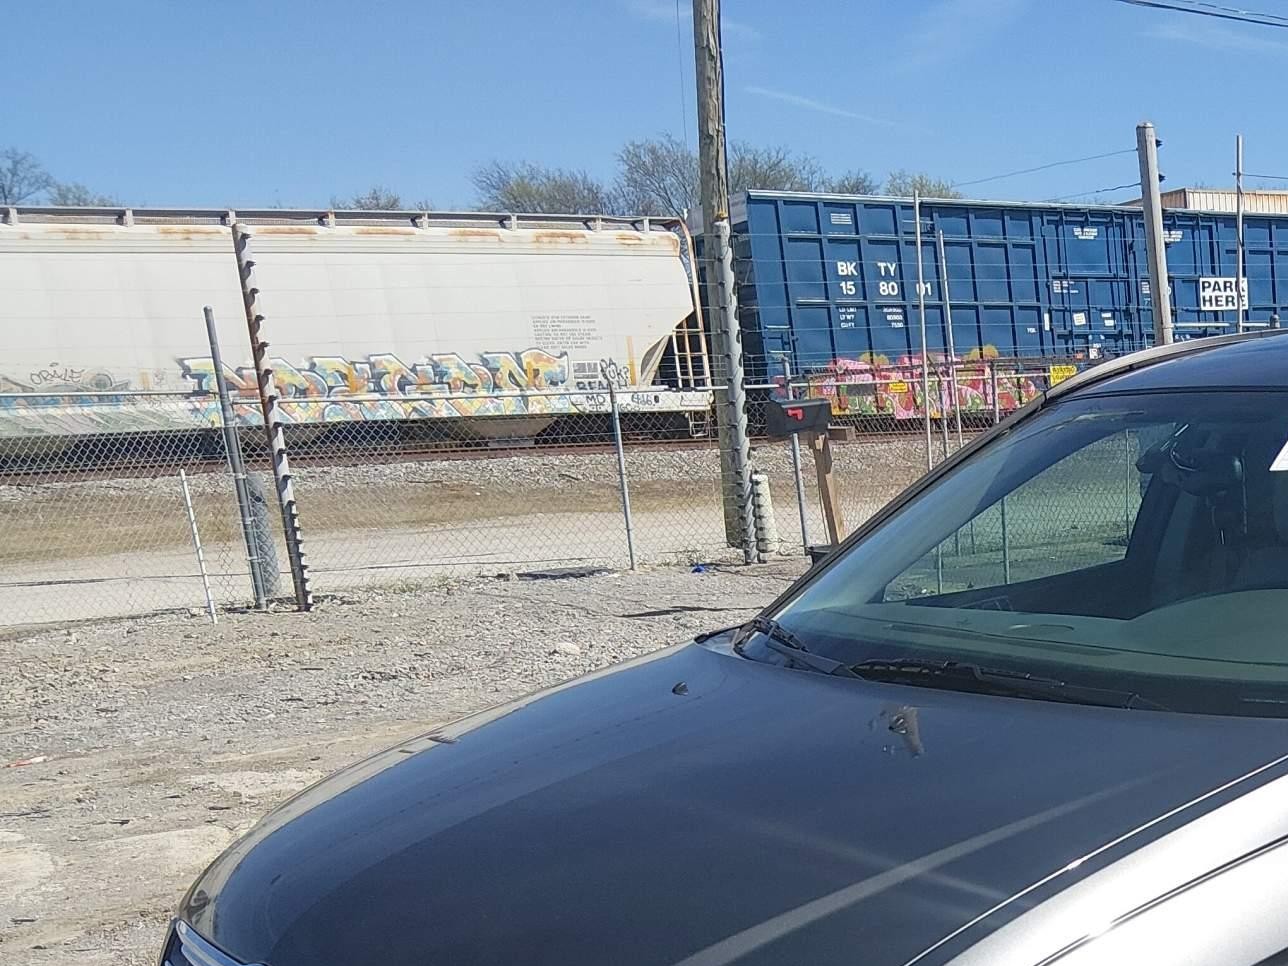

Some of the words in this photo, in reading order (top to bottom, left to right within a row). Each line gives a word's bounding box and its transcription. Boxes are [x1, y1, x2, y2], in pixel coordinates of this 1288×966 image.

[837, 261, 858, 276] BK
[877, 262, 896, 277] TY
[840, 281, 856, 295] 15
[879, 282, 898, 296] 80
[1201, 280, 1246, 293] PARK
[1202, 295, 1246, 307] HERE
